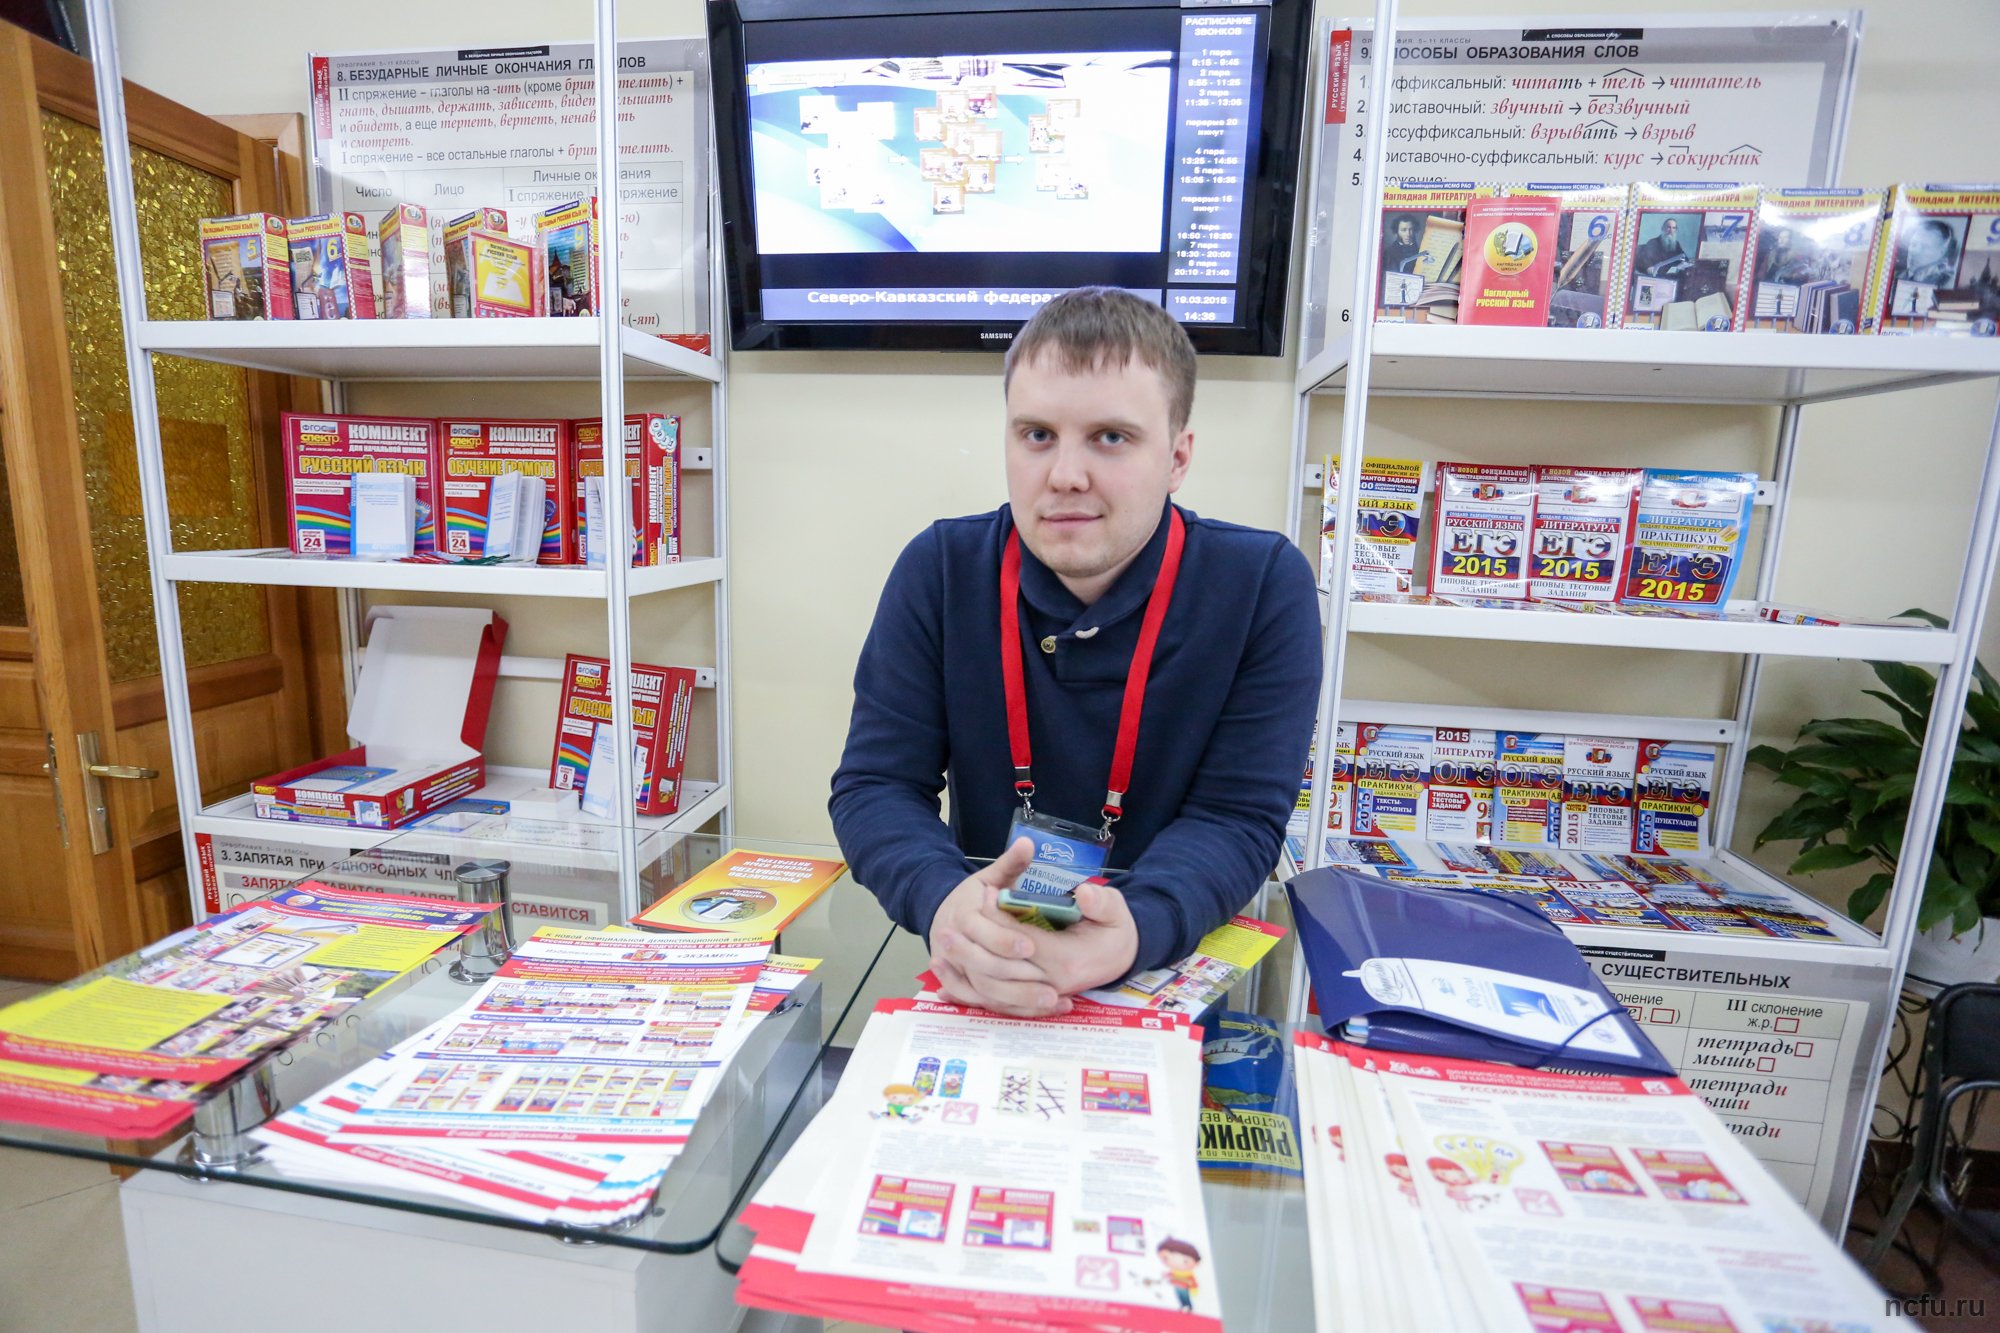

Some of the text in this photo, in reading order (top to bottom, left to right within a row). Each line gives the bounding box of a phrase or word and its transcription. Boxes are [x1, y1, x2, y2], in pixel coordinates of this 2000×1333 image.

[1185, 17, 1252, 26] РАСПИСАНИЕ
[1361, 44, 1639, 59] 9. ОБРАЗОВАНИЯ СЛОВ
[337, 72, 347, 82] 8.
[350, 66, 429, 81] БЕЗУДАРНЫЕ
[436, 64, 488, 77] ЛИЧНЫЕ
[494, 60, 572, 74] ОКОНЧАНИЯ
[339, 82, 561, 100] II спряжение глаголы на -ить (кроме
[1332, 71, 1340, 108] РУССКИЙ
[1360, 75, 1370, 89] 1.
[1512, 75, 1583, 91] читать
[1669, 75, 1761, 91] читатель
[340, 99, 556, 118] гнать, дышать, держать, зависеть,
[1357, 98, 1691, 119] 2. звучный беззвучный
[350, 112, 557, 133] обидеть, а еще терпеть, вертеть,
[1355, 122, 1696, 143] 3. взрывать взрыв
[350, 137, 413, 150] смотреть.
[350, 147, 554, 164] спряжение все остальные глаголы
[1353, 147, 1762, 168] 4. курс сокурсник
[533, 170, 580, 183] Личные
[355, 183, 464, 199] Число Лицо
[1384, 192, 1477, 201] Наглядная ЛИТЕРАТУРА
[1588, 215, 1608, 240] 6
[1722, 215, 1744, 242] 7
[328, 240, 337, 257] 6
[807, 291, 978, 305] Северо-Кавказский
[1484, 289, 1529, 298] Наглядный
[1476, 298, 1534, 308] РУССКИЙ ЯЗЫК
[980, 332, 1013, 340] SAMSUNG
[349, 424, 427, 441] КОМПЛЕКТ
[489, 426, 556, 443] КОМПЛЕКТ
[300, 455, 426, 477] РУССКИЙ ЯЗЫК
[448, 459, 554, 477] ОБУЧЕНИЕ ГРАМОТЕ
[1366, 462, 1420, 472] ОФИЦИАЛЬНОЙ
[1446, 518, 1523, 531] РУССКИЙ ЯЗЫК
[1541, 520, 1616, 533] ЛИТЕРАТУРА
[1646, 515, 1724, 528] ЛИТЕРАТУРА
[303, 537, 322, 548] 24
[452, 538, 467, 549] 24
[1451, 529, 1517, 556] ЕГЭ
[1538, 531, 1612, 558] ЕГЭ
[1640, 530, 1717, 545] ПРАКТИКУМ
[1453, 556, 1507, 577] 2015
[1540, 558, 1600, 580] 2015
[1638, 549, 1724, 580] ЕГЭ
[1440, 578, 1476, 586] ТИПОВЫЕ
[1461, 586, 1498, 595] ЗАДАНИЯ
[1569, 583, 1611, 592] ТЕСТОВЫЕ
[1639, 578, 1706, 601] 2015
[1547, 590, 1587, 598] ЗАДАНИЯ
[1438, 730, 1469, 742] 2015
[1368, 749, 1424, 760] РУССКИЙ ЯЗЫК
[1503, 754, 1562, 765] РУССКИЙ ЯЗЫК
[562, 774, 568, 782] 9
[1364, 758, 1421, 783] ЕГЭ
[1433, 760, 1495, 786] ОГЭ
[1500, 763, 1563, 789] ОГЭ
[1567, 768, 1631, 778] РУССКИЙ ЯЗЫК
[1650, 767, 1707, 778] РУССКИЙ ЯЗЫК
[1360, 781, 1413, 791] ПРАКТИКУМ
[1501, 788, 1547, 798] ПРАКТИКУМ
[1570, 780, 1626, 805] ЕГЭ
[1644, 776, 1702, 802] ЕГЭ
[295, 790, 344, 802] КОМПЛЕКТ
[1357, 789, 1371, 831] 2015
[1477, 802, 1488, 819] 9
[1641, 802, 1691, 812] ПРАКТИКУМ
[1567, 813, 1578, 844] 2015
[1654, 817, 1698, 827] ПУНКТУАЦИЯ
[1642, 814, 1652, 848] 2015
[221, 850, 428, 879] 3. ЗАПЯТАЯ ПРИ ОДНОРОДНЫХ
[1556, 880, 1602, 890] 2015
[511, 902, 589, 922] СТАВИТСЯ
[1601, 962, 1791, 989] СУЩЕСТВИТЕЛЬНЫХ
[1726, 998, 1824, 1018] III склонение
[1747, 1016, 1773, 1030] ж.р.
[1697, 1036, 1794, 1056] тетрадь
[1692, 1054, 1756, 1070] мышь
[1690, 1077, 1788, 1098] тетради
